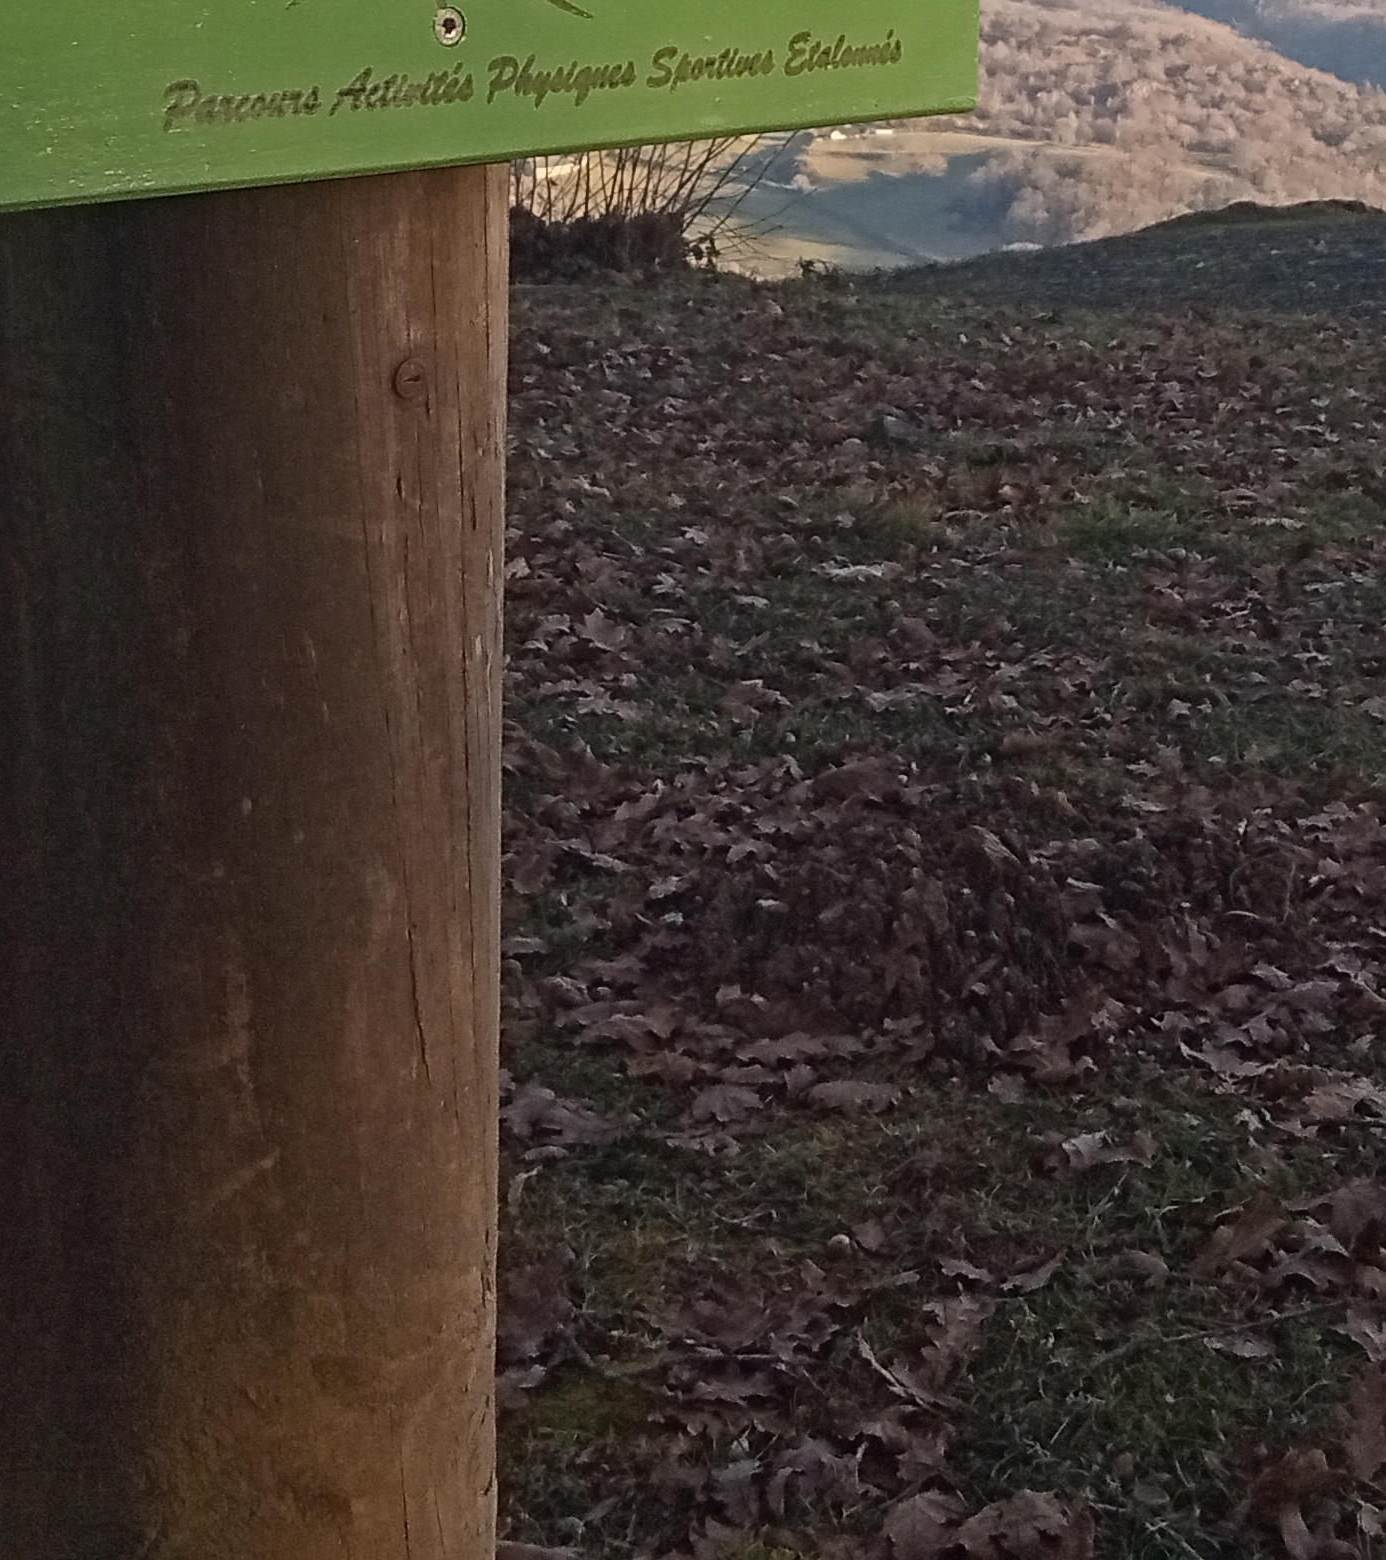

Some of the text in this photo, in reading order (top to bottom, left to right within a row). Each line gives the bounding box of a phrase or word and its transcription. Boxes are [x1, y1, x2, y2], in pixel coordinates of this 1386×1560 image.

[162, 78, 322, 133] Parcours
[328, 61, 475, 117] Activités
[487, 54, 637, 109] Physiques
[646, 46, 775, 93] Sportives
